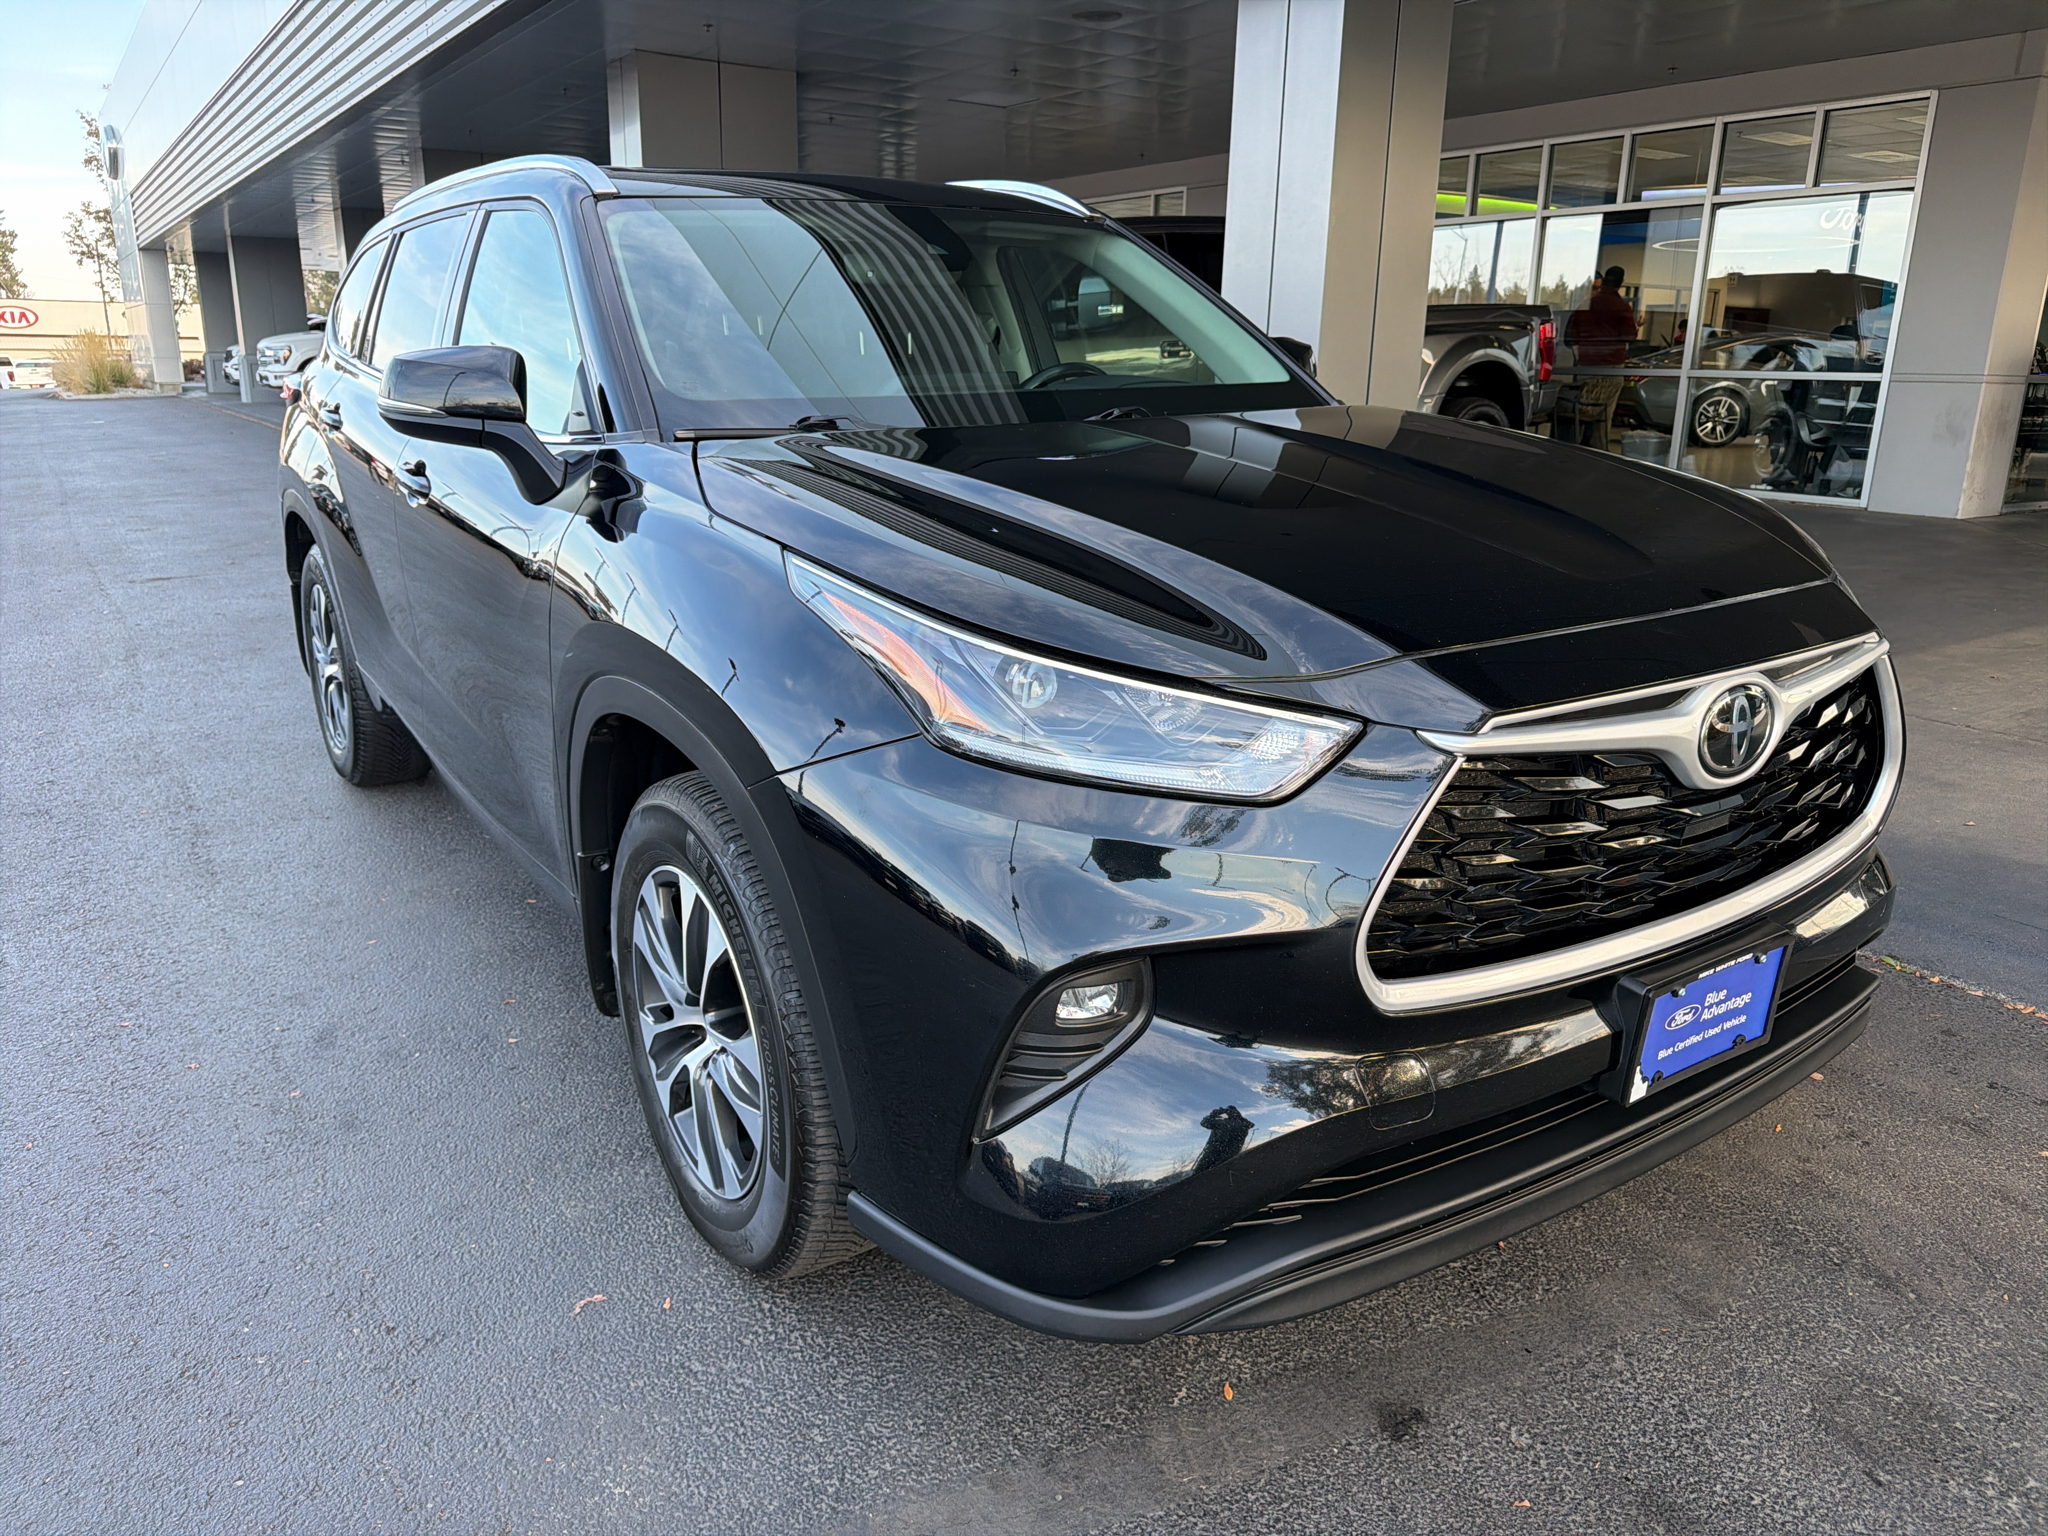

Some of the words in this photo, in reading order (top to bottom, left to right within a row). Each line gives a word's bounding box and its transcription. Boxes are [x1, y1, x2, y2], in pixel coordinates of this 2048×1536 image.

[0, 311, 31, 324] KIA
[708, 873, 763, 999] MICHELIN
[1699, 992, 1752, 1022] Advantage
[1704, 989, 1727, 1007] Blue
[1671, 1008, 1695, 1028] Ford
[1657, 1046, 1674, 1060] Blue
[1674, 1031, 1704, 1052] Certified
[1704, 1023, 1722, 1038] Used
[1723, 1014, 1747, 1030] Vehicle
